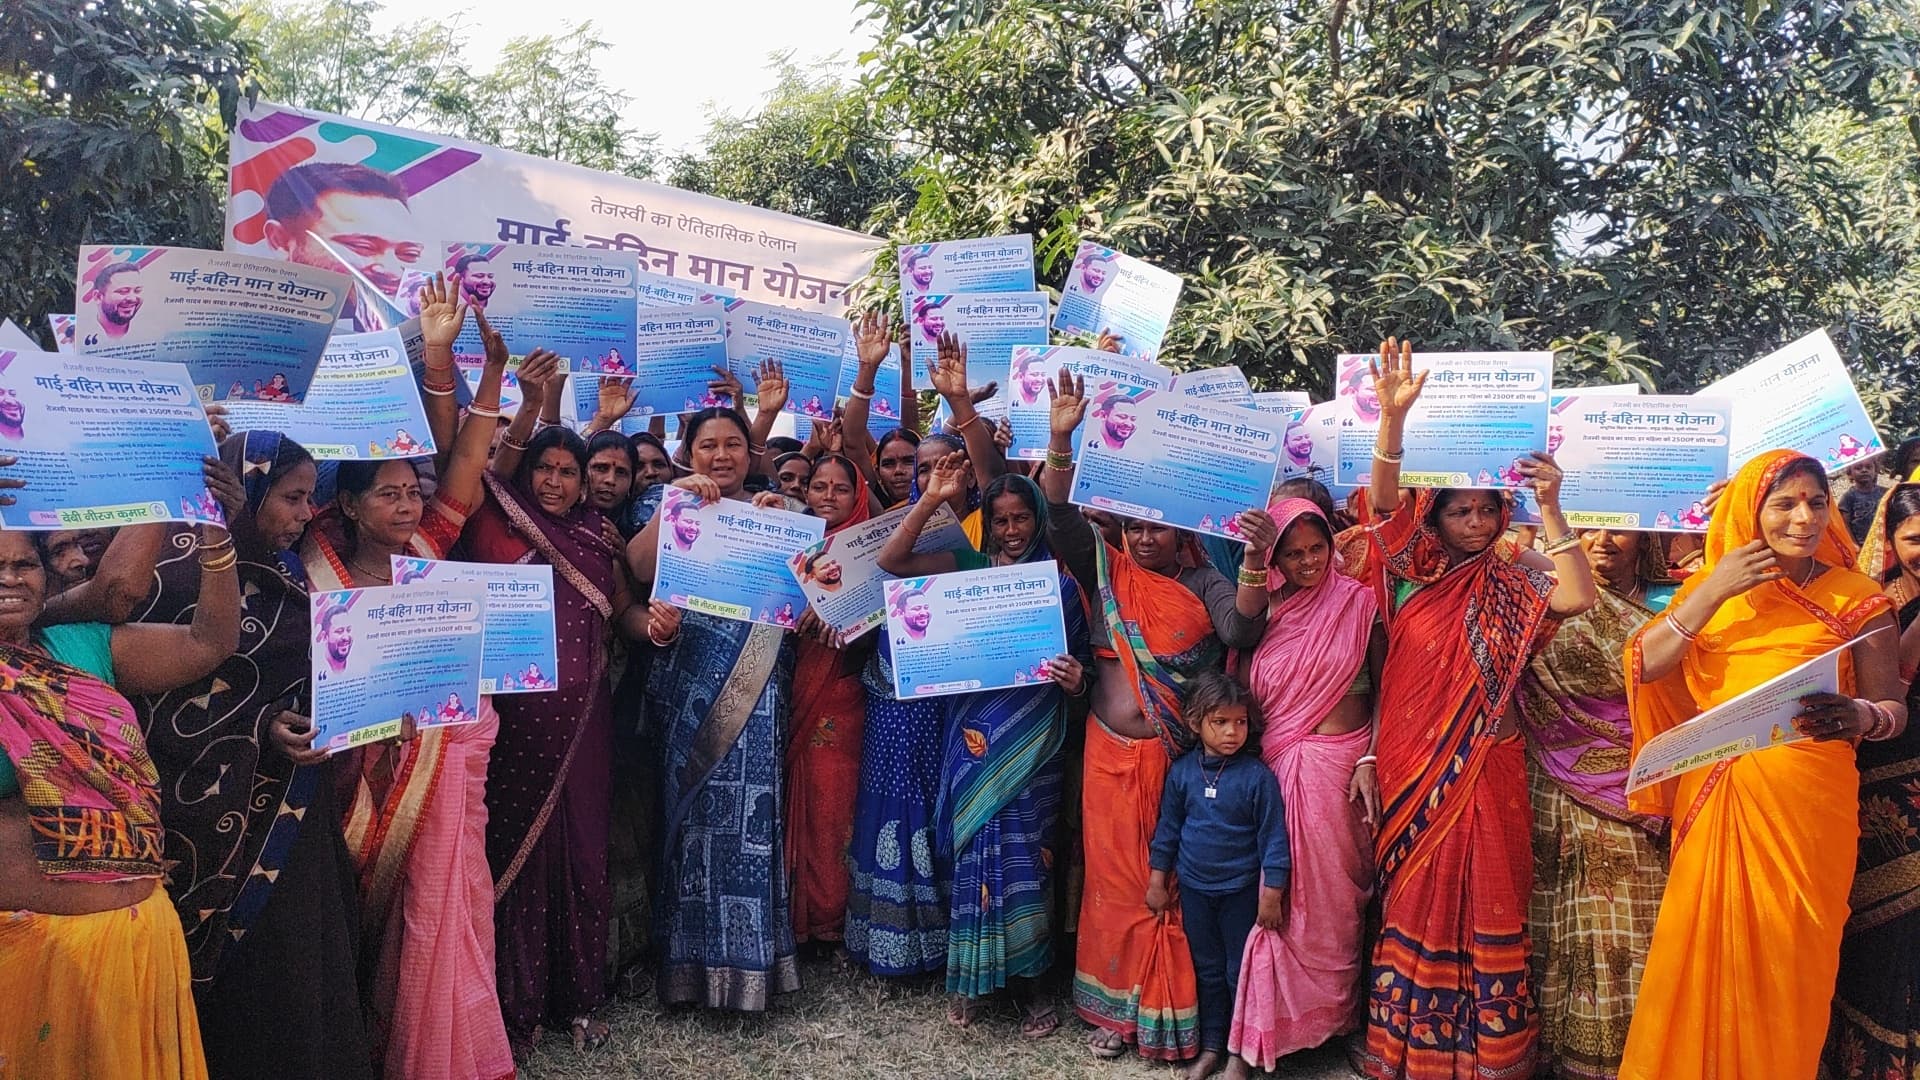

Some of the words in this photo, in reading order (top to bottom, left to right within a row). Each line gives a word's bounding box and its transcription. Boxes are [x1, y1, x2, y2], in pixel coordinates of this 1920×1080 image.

[591, 197, 646, 223] तेजस्वी
[651, 212, 672, 228] का
[677, 214, 753, 244] ऐतिहासिक
[758, 231, 797, 254] ऐलान
